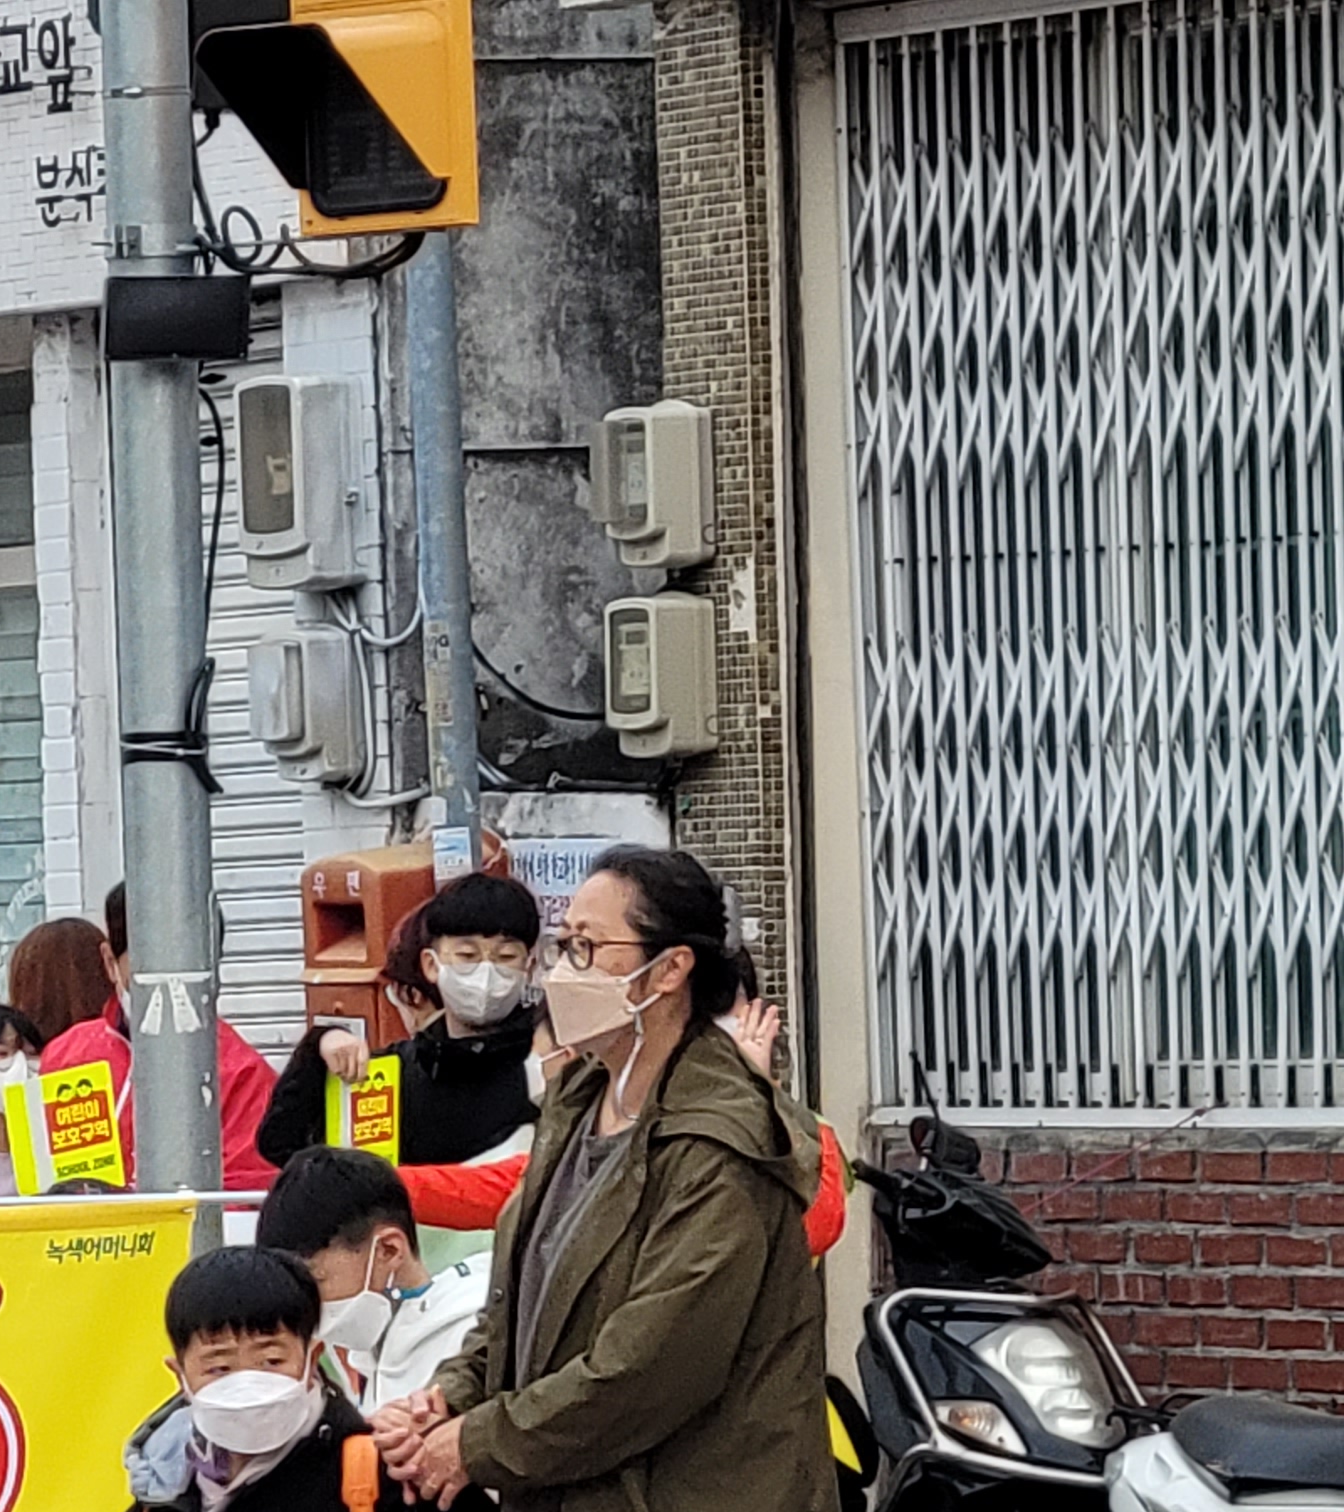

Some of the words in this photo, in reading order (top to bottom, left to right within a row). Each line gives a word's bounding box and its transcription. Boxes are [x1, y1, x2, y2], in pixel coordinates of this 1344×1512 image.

[54, 1098, 101, 1127] 어린이
[51, 1118, 110, 1151] 보호구역
[45, 1231, 156, 1265] 녹색어머니회
